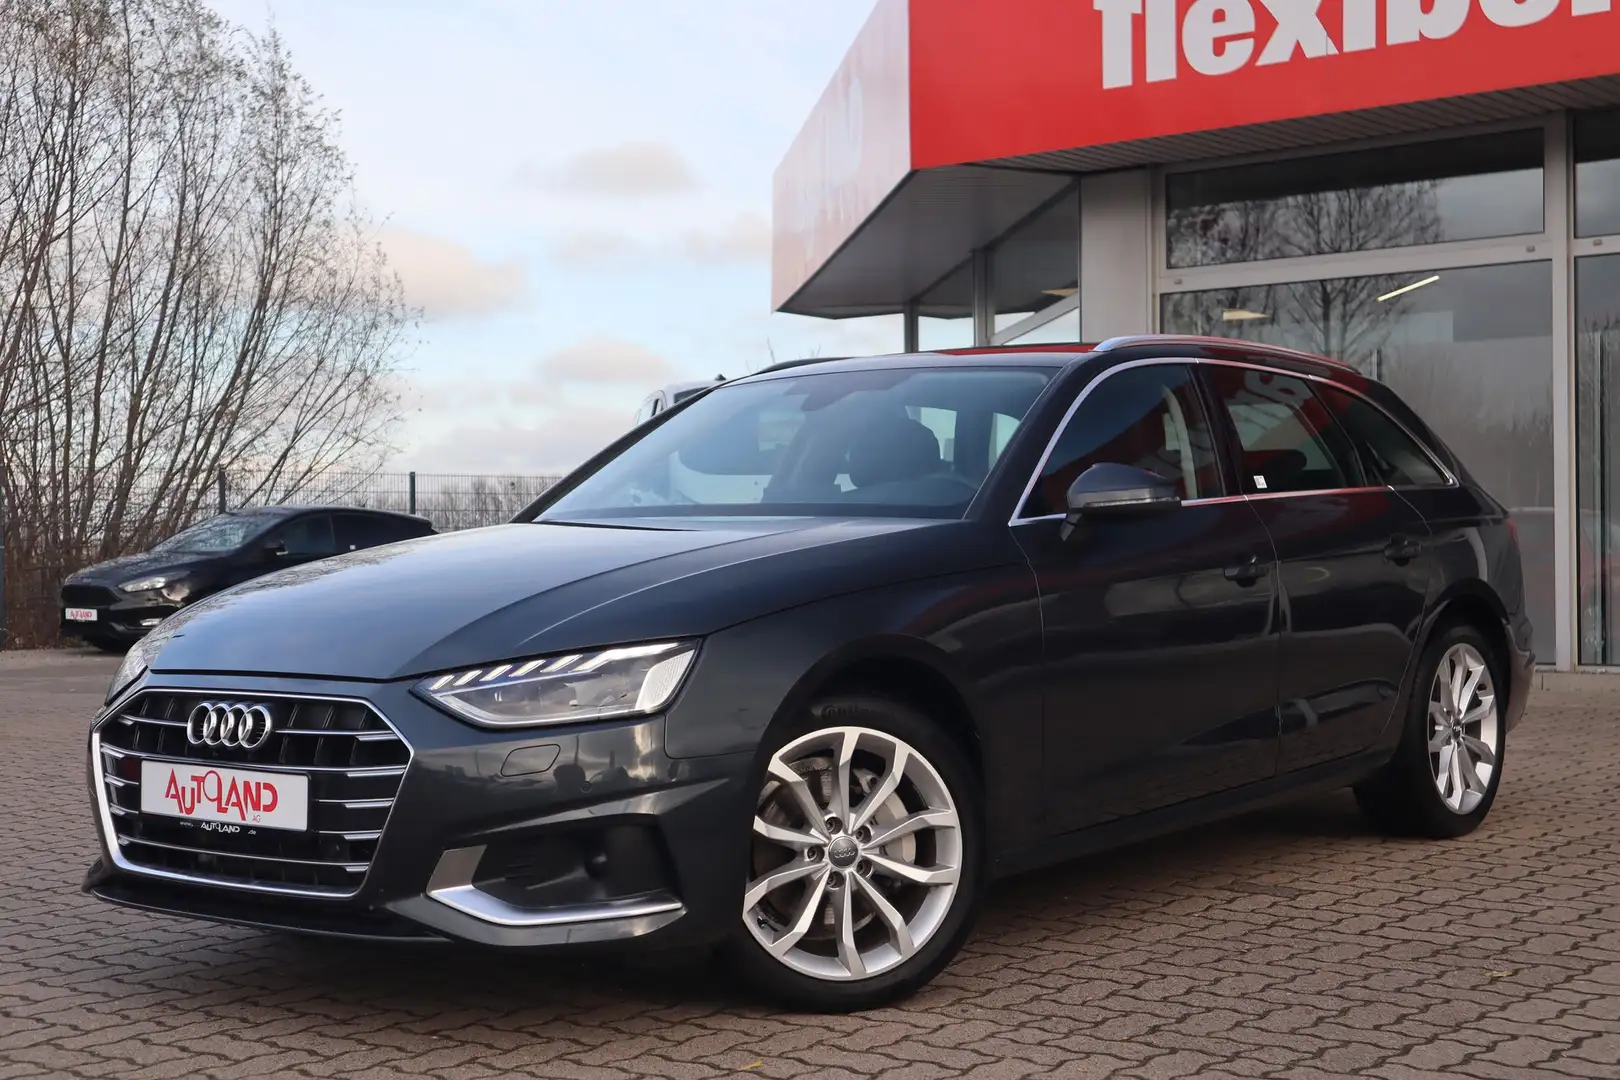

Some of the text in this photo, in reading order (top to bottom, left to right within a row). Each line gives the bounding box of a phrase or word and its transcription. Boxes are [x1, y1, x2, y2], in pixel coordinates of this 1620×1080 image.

[1093, 0, 1612, 89] flexi
[165, 768, 278, 821] AUTOLAND
[252, 815, 261, 823] AG
